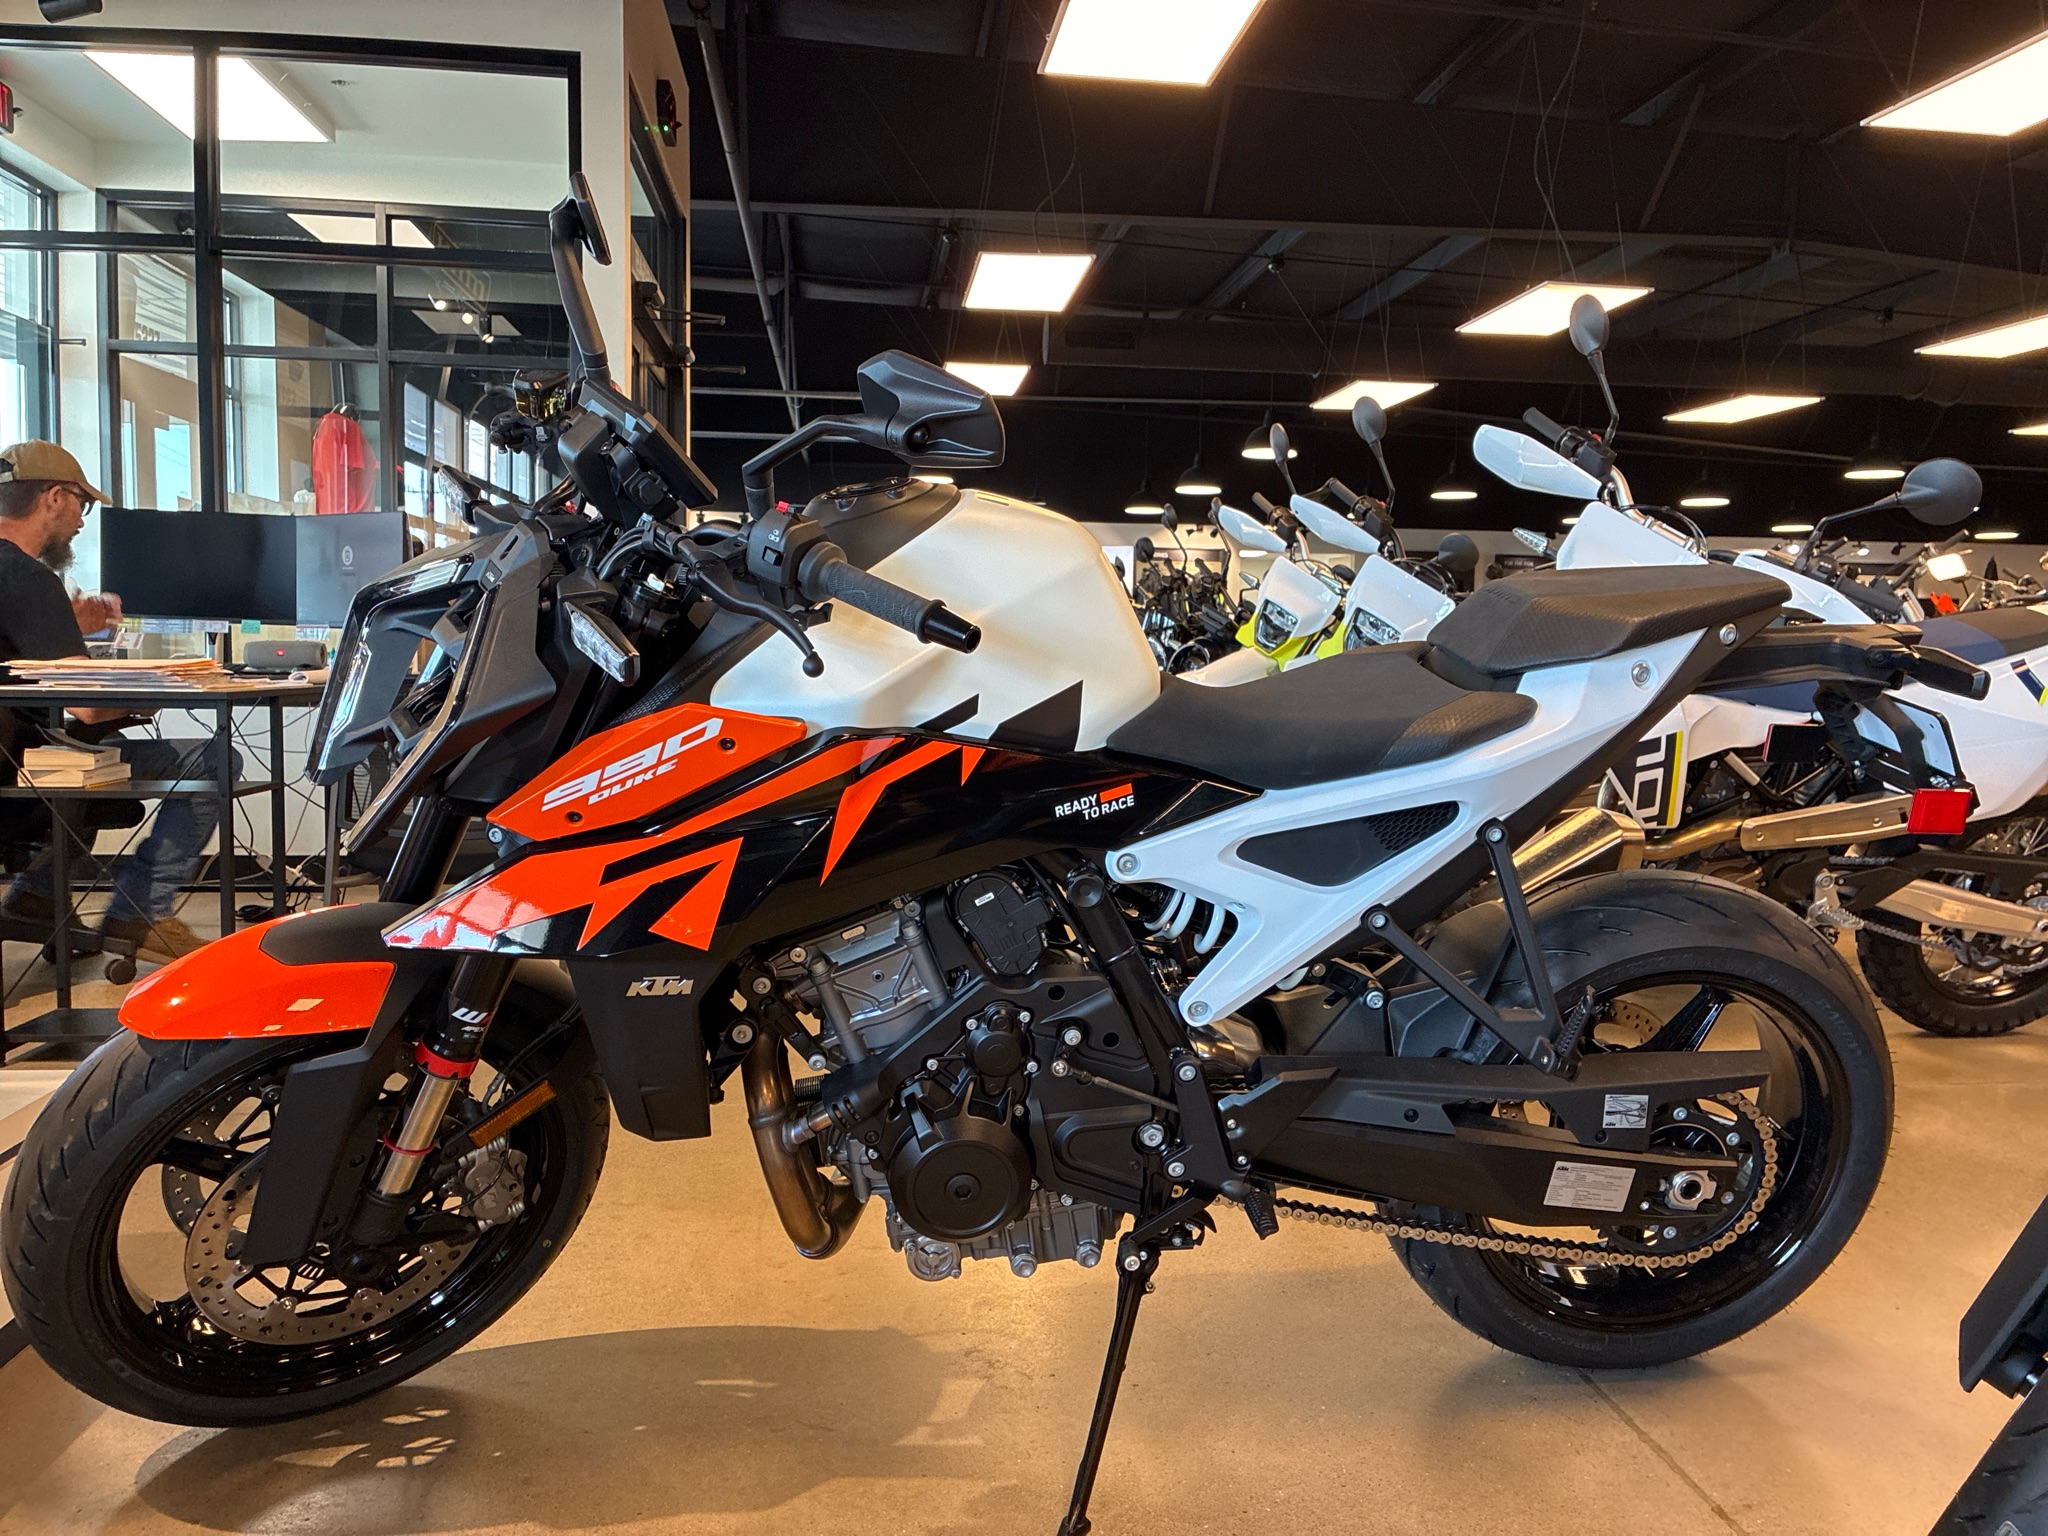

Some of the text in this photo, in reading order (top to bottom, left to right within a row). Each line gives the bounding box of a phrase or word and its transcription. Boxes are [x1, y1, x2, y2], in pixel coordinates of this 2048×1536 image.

[541, 717, 724, 812] 990
[588, 758, 678, 805] DUKE
[1055, 793, 1097, 818] READY
[1082, 794, 1135, 820] TO RACE
[625, 975, 694, 996] KTM
